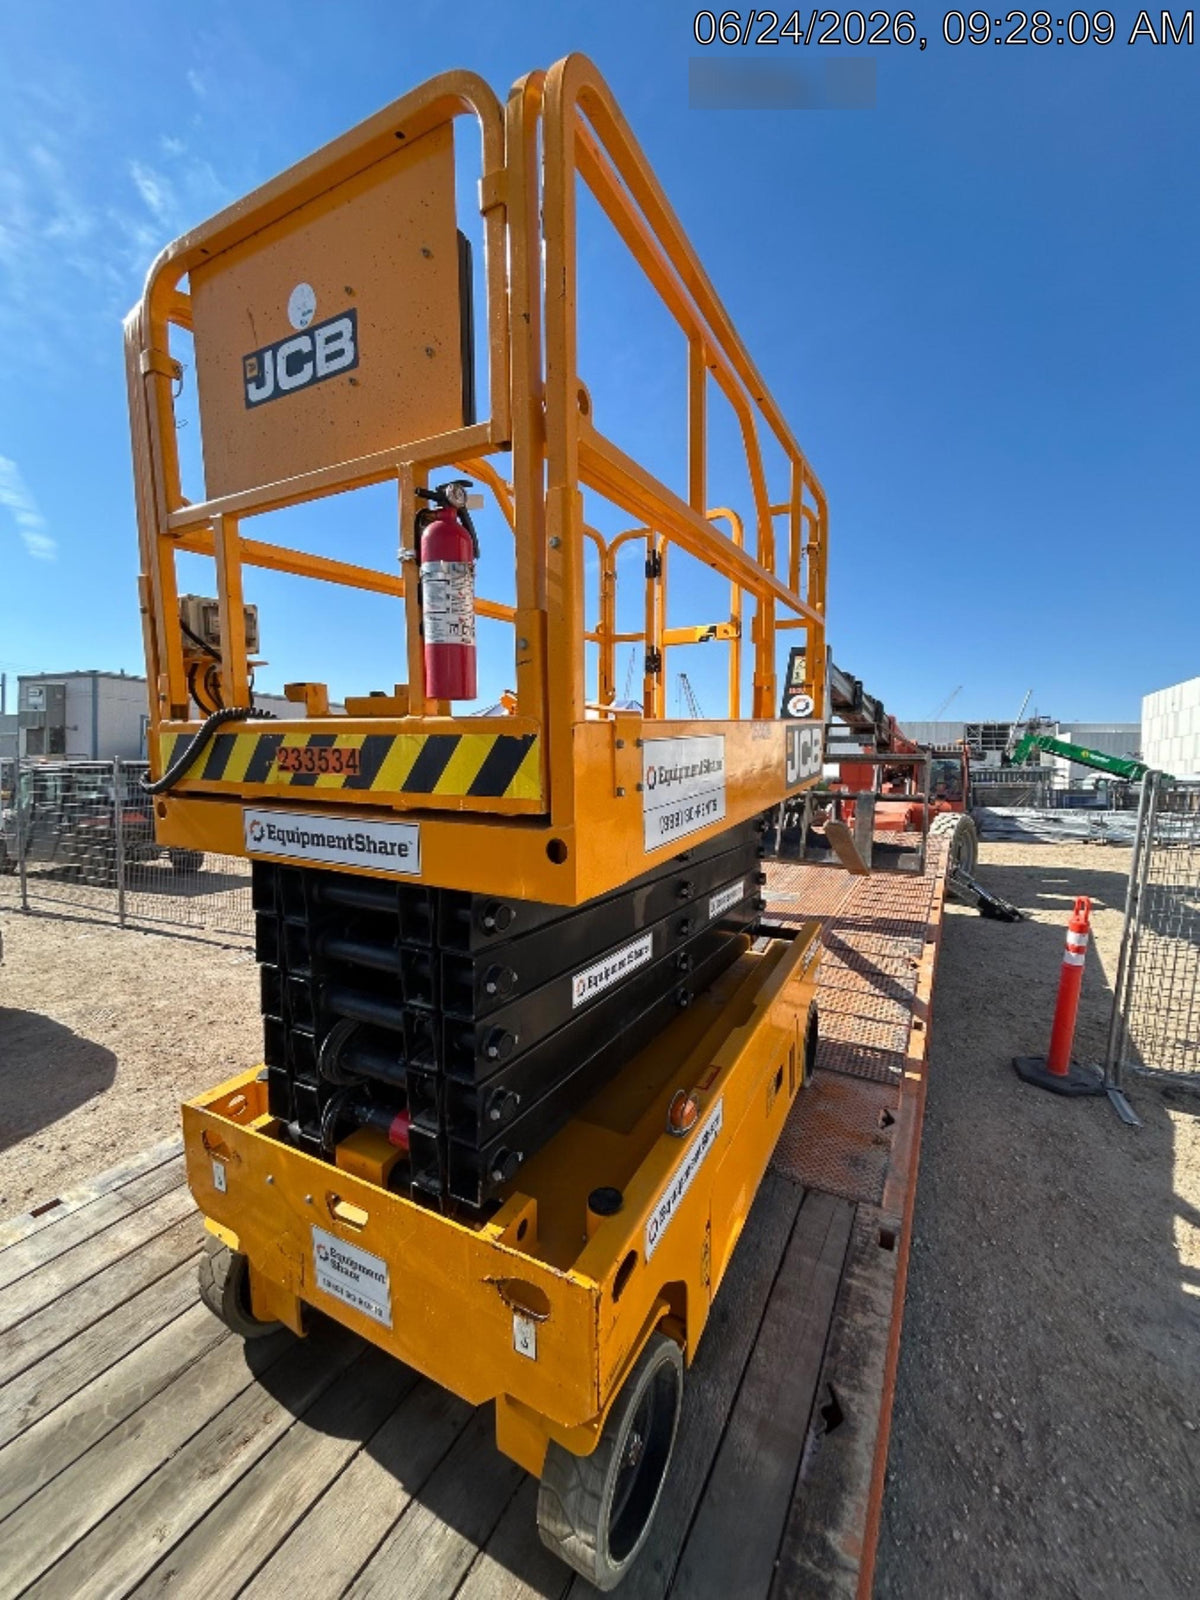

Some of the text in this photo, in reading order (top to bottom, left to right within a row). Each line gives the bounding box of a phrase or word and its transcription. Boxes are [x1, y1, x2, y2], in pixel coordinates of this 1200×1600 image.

[247, 317, 355, 402] JCB
[278, 747, 359, 773] 233534
[786, 728, 823, 783] JCB
[265, 822, 409, 858] EquipmentShare
